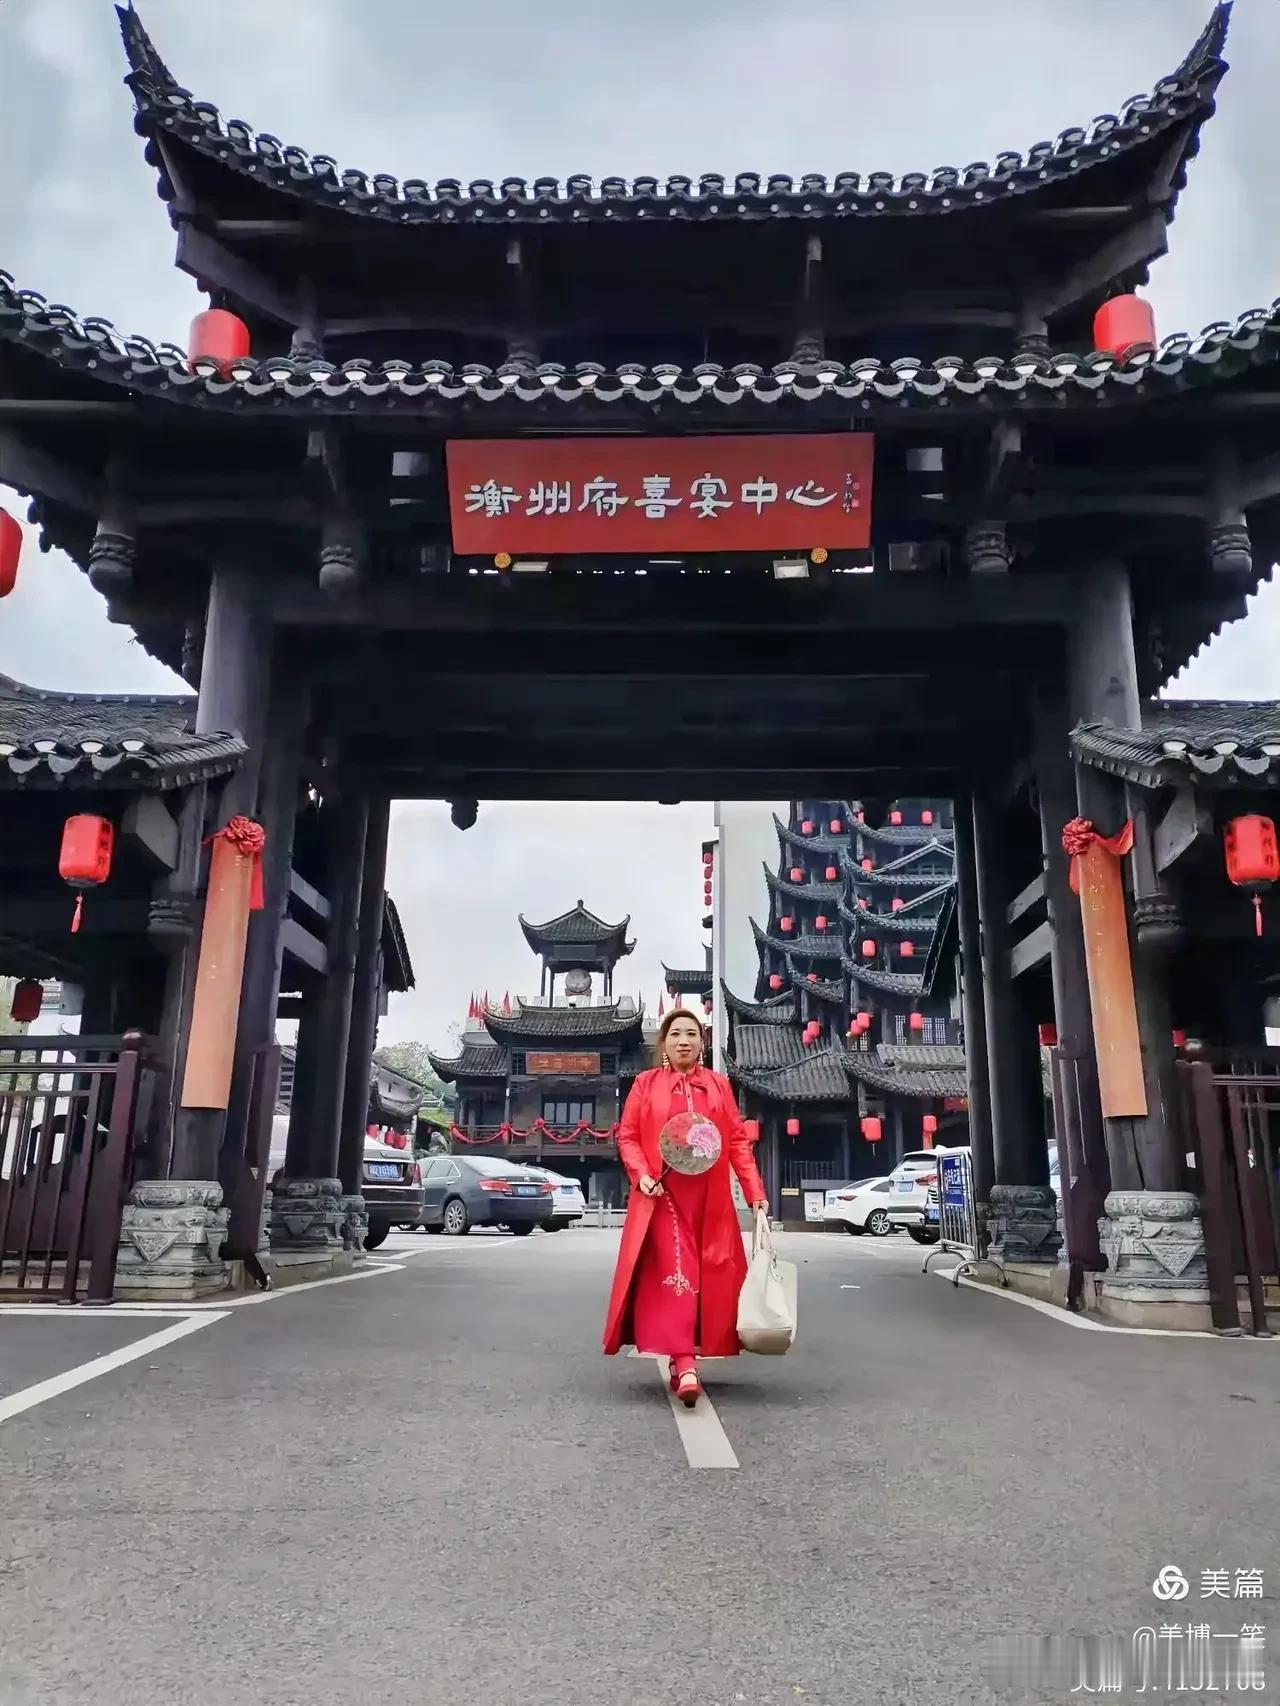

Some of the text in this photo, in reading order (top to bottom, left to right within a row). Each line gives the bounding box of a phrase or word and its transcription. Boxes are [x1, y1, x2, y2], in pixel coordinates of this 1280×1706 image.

[464, 472, 838, 519] 衡州府喜宴中心
